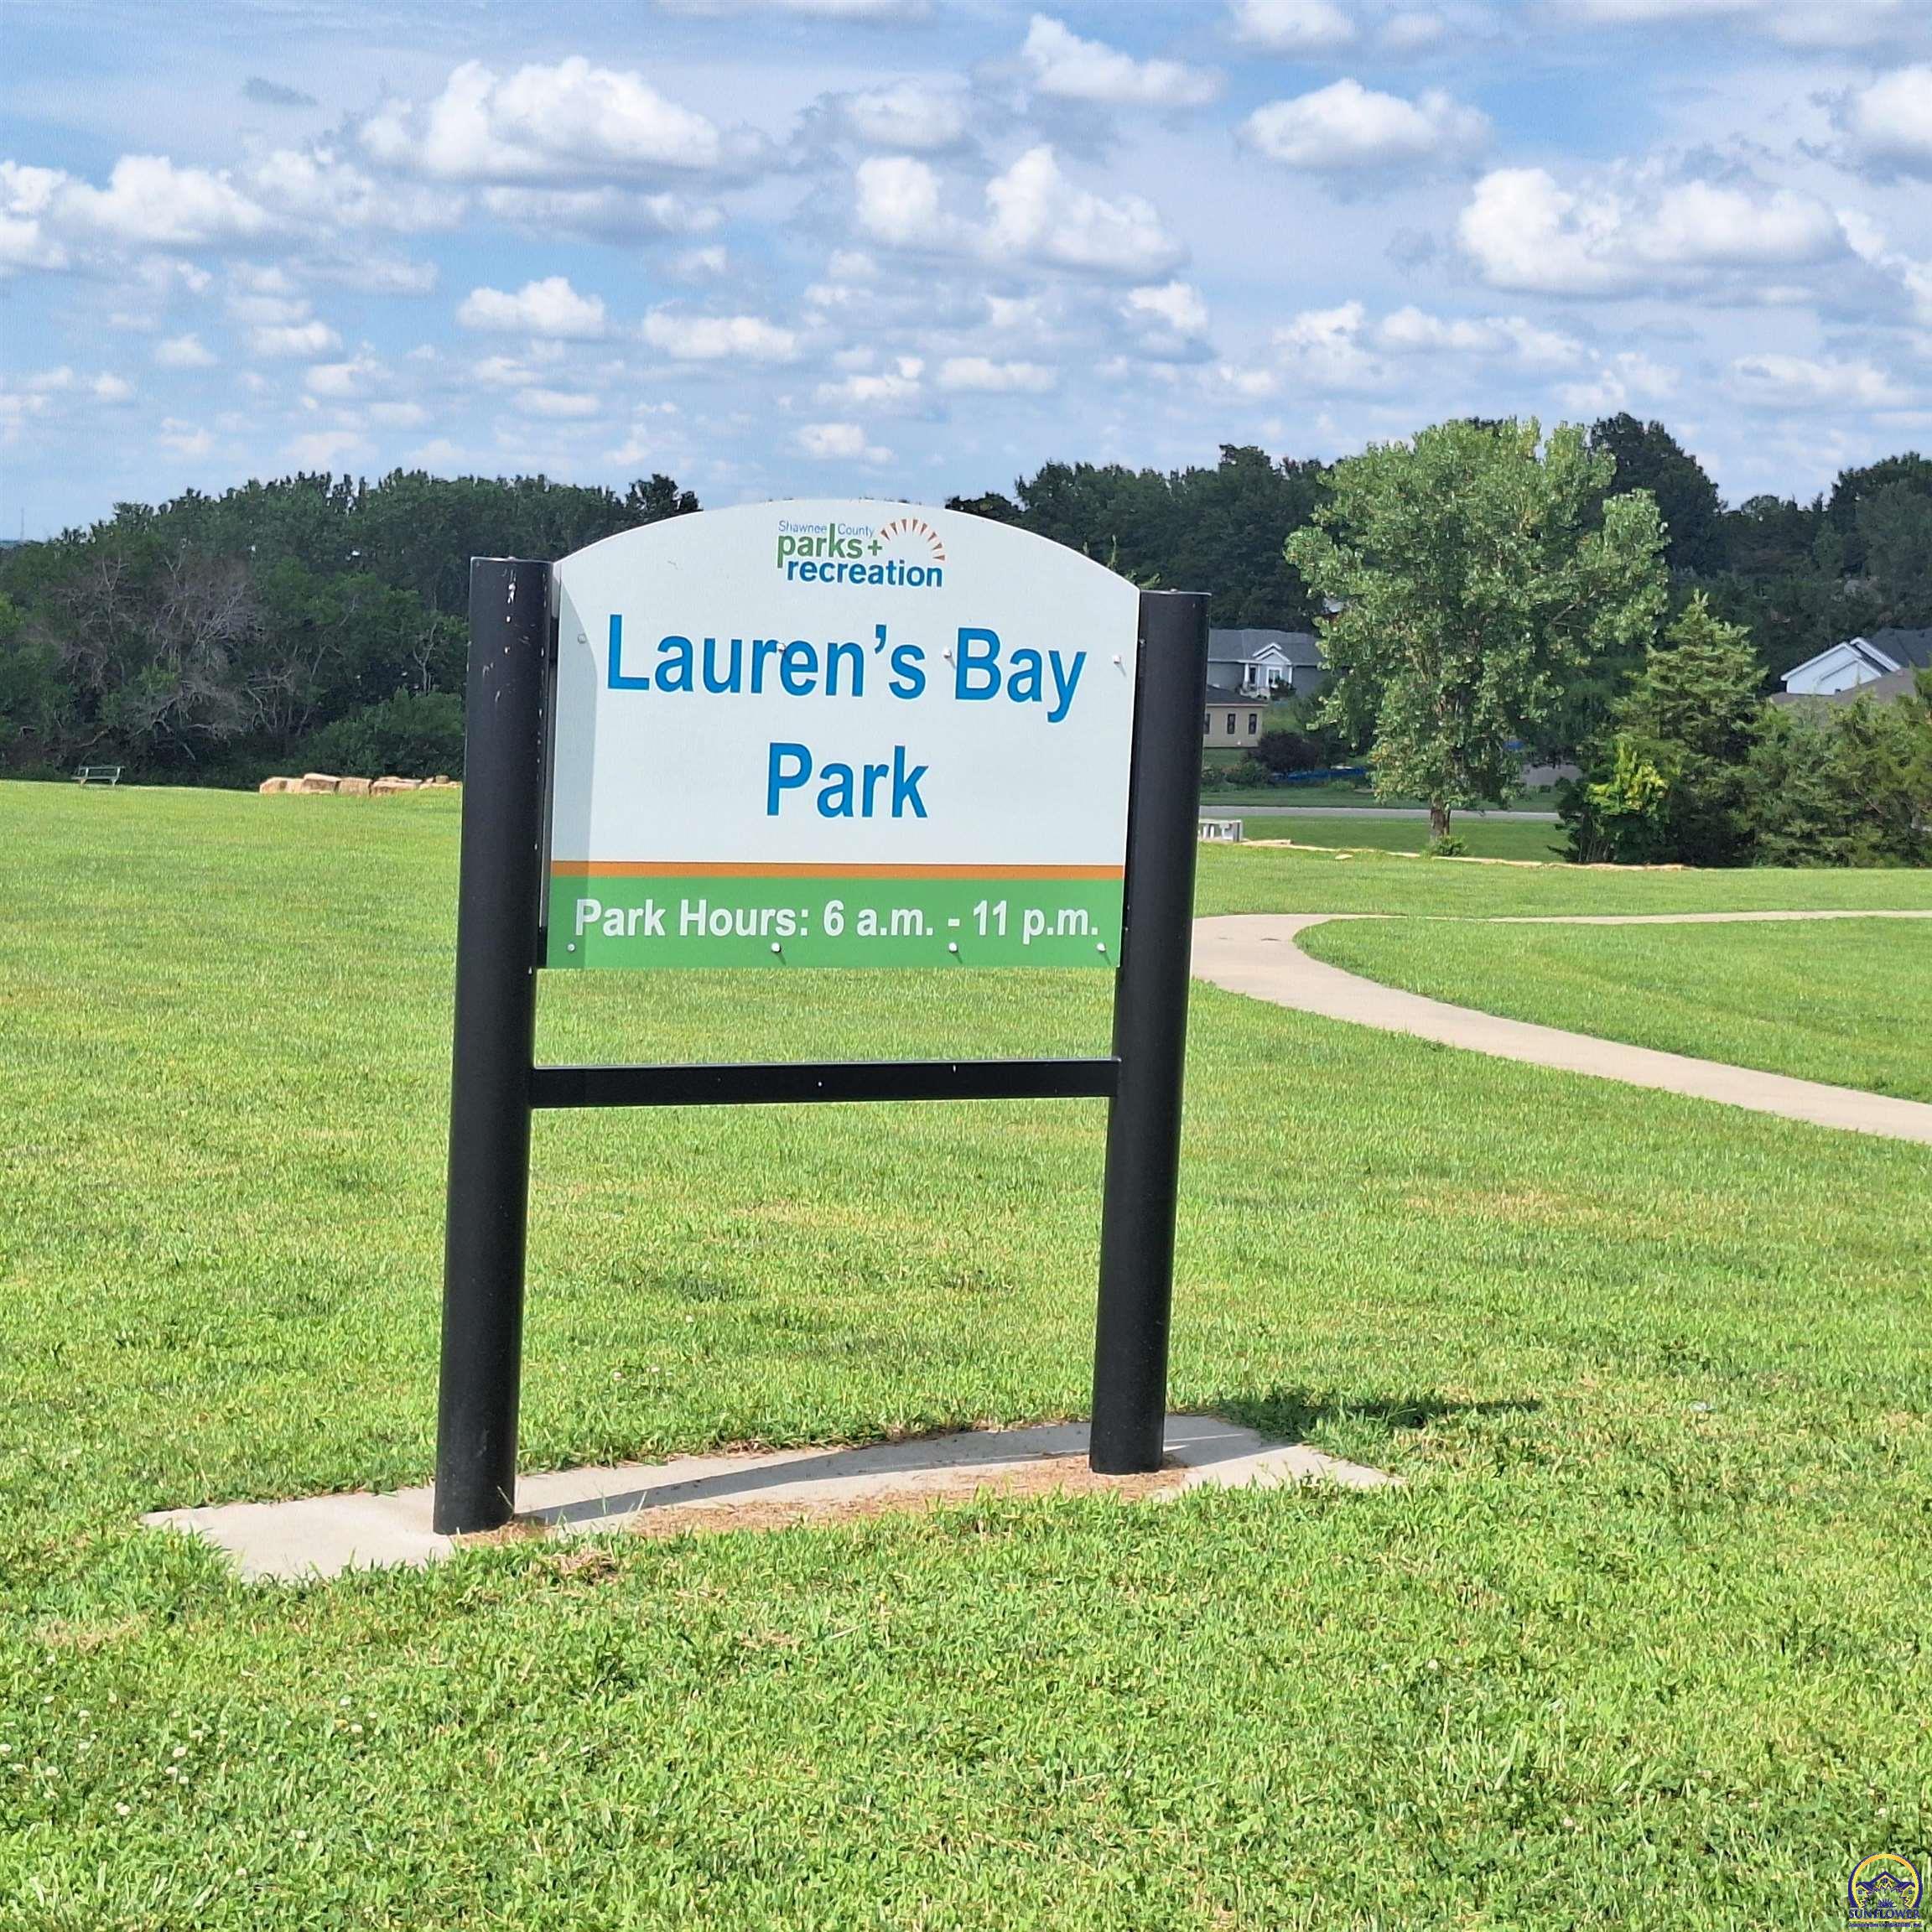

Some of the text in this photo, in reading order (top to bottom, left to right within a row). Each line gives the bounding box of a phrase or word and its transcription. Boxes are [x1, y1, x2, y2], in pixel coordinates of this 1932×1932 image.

[778, 520, 875, 538] Shawnee County
[787, 559, 943, 588] recreation
[606, 614, 1088, 724] Lauren's Bay
[766, 741, 930, 820] Park
[574, 898, 667, 937] Park
[678, 899, 810, 937] Hours:
[823, 900, 845, 937] 6
[856, 906, 934, 937] a.m.
[972, 900, 1008, 937] 11
[1021, 907, 1100, 945] p.m.
